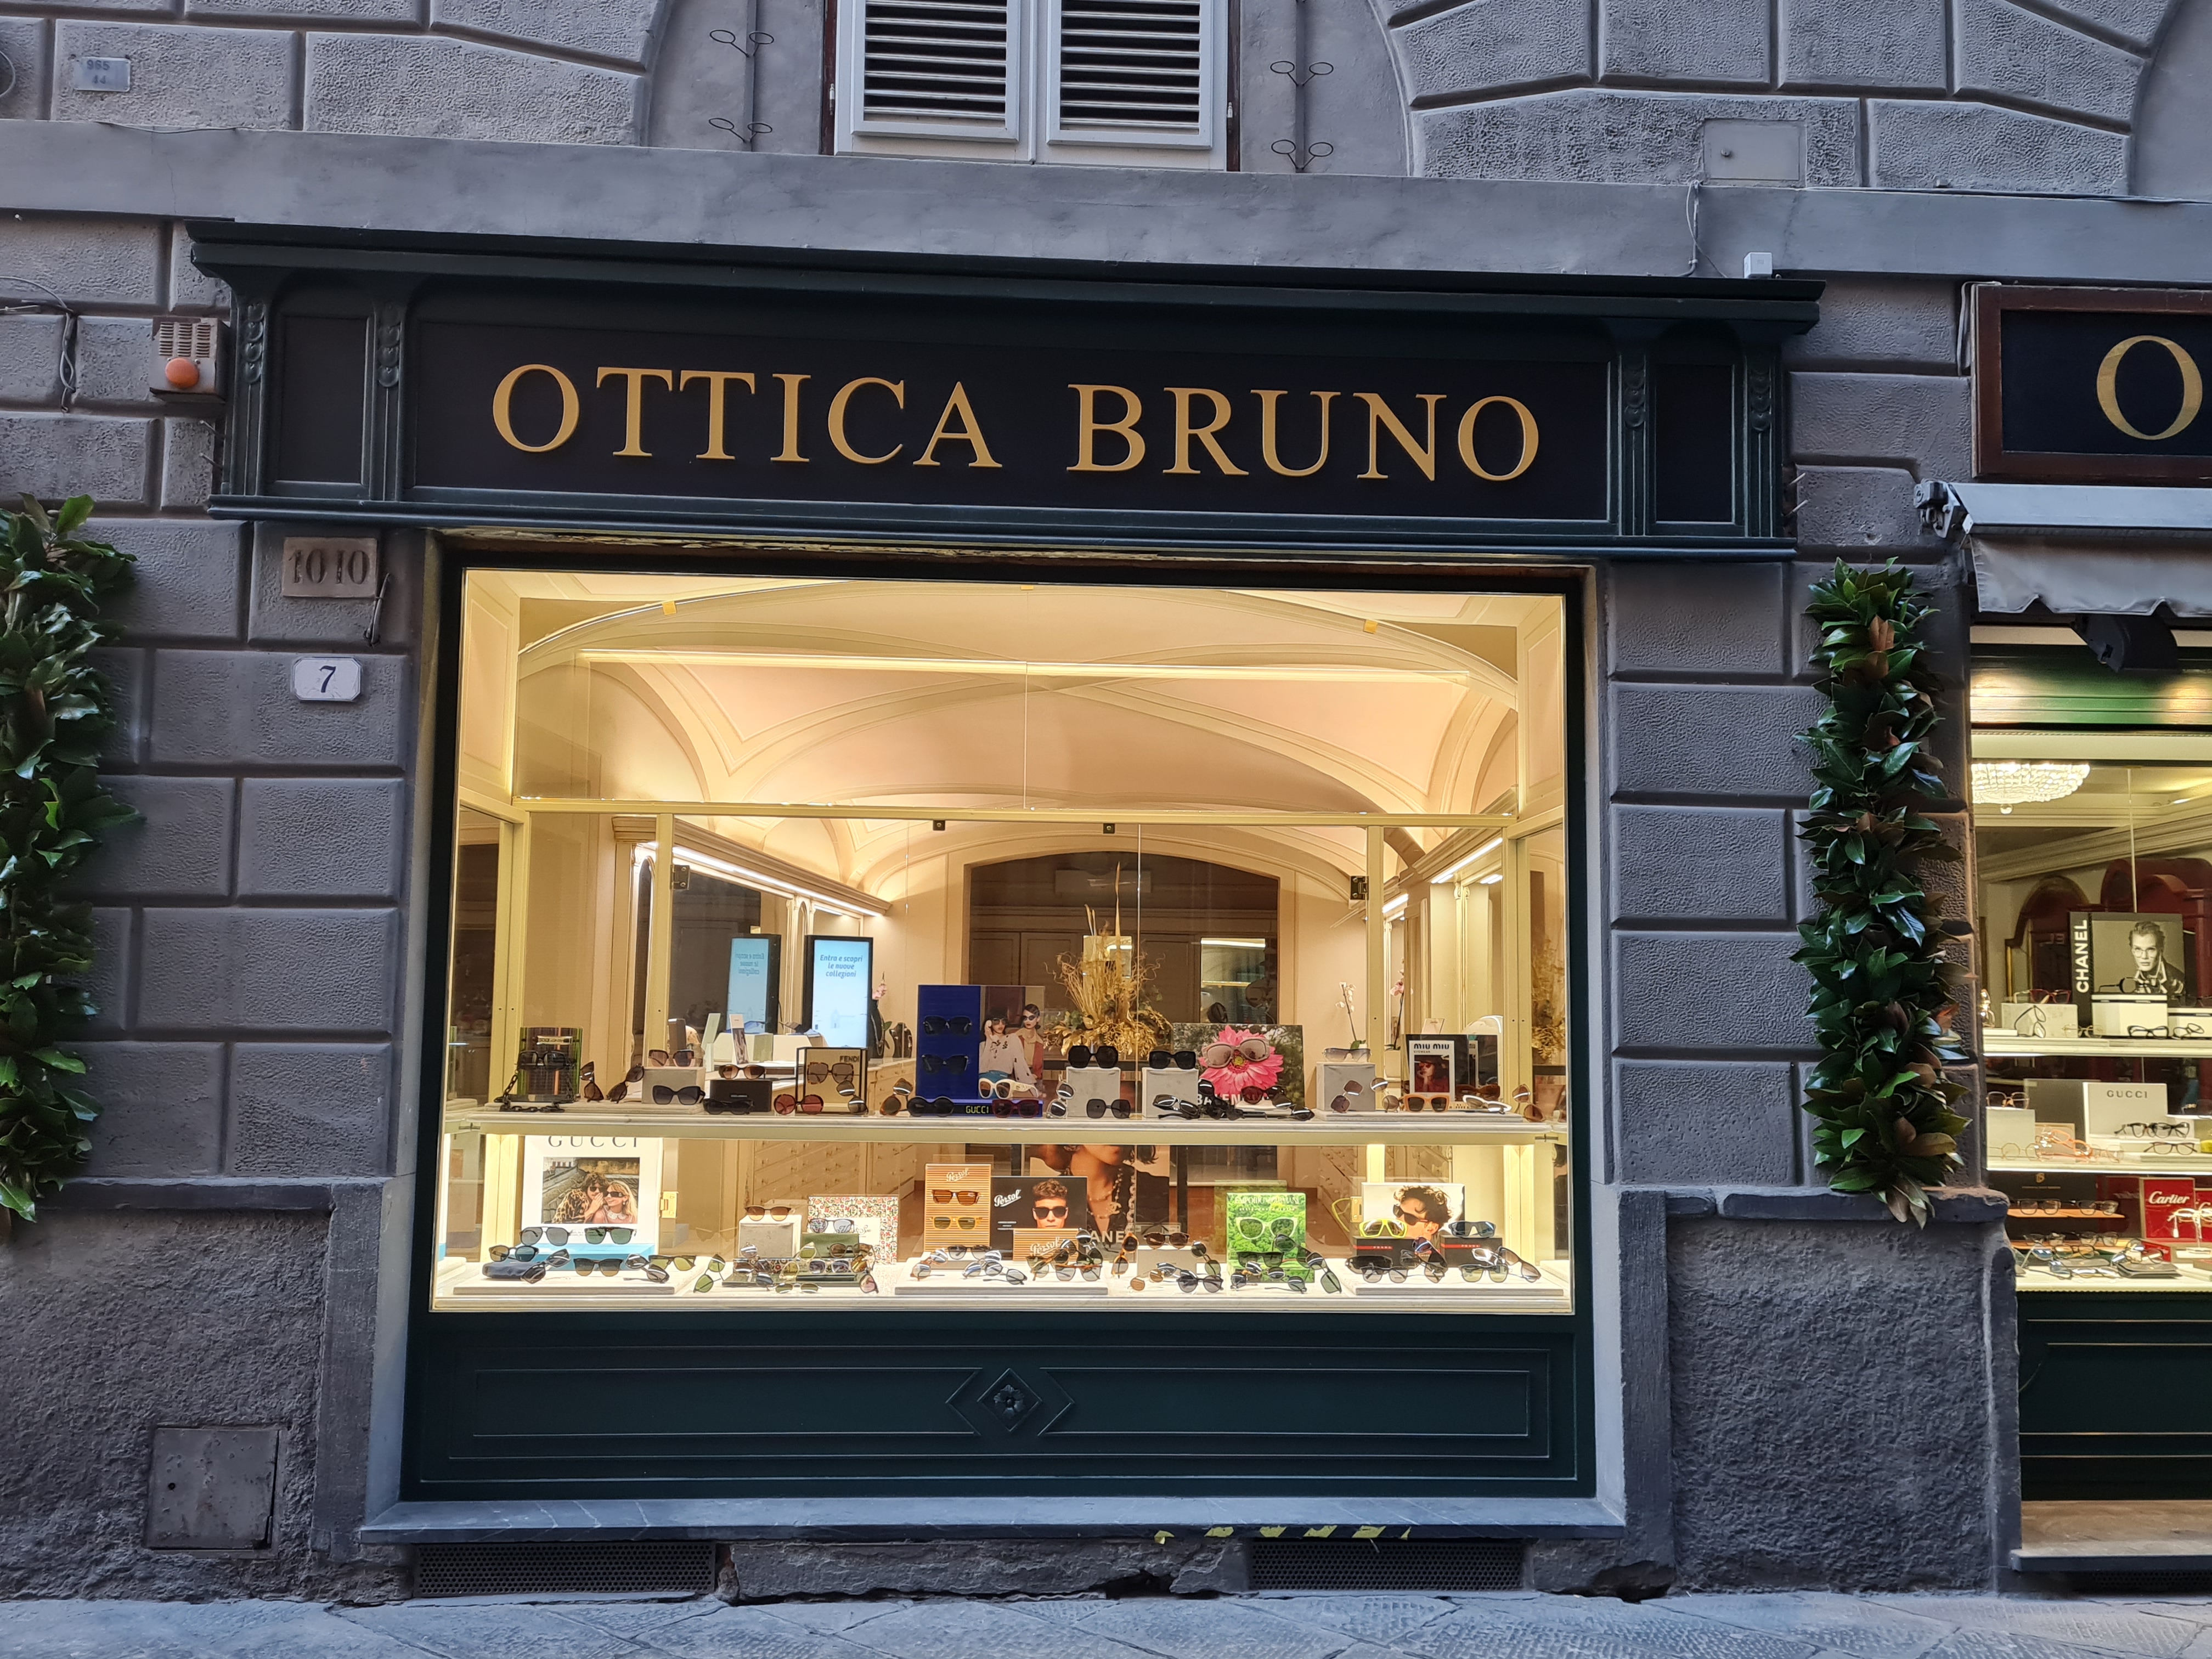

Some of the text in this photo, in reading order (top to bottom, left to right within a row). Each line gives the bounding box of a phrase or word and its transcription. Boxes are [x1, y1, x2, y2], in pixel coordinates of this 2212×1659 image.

[2096, 335, 2203, 441] O
[492, 363, 1539, 482] OTTICA BRUNO
[319, 665, 336, 693] 7
[843, 955, 863, 963] scopri
[2073, 919, 2089, 994] CHANEL
[826, 970, 856, 979] collezioni
[2107, 1090, 2147, 1098] GUCCI
[966, 1105, 989, 1114] GUCCI
[548, 1136, 637, 1148] GUCCI
[946, 1167, 970, 1182] Persol
[994, 1189, 1022, 1207] Persol
[2148, 1190, 2190, 1204] Cartier
[1030, 1235, 1060, 1256] Persol
